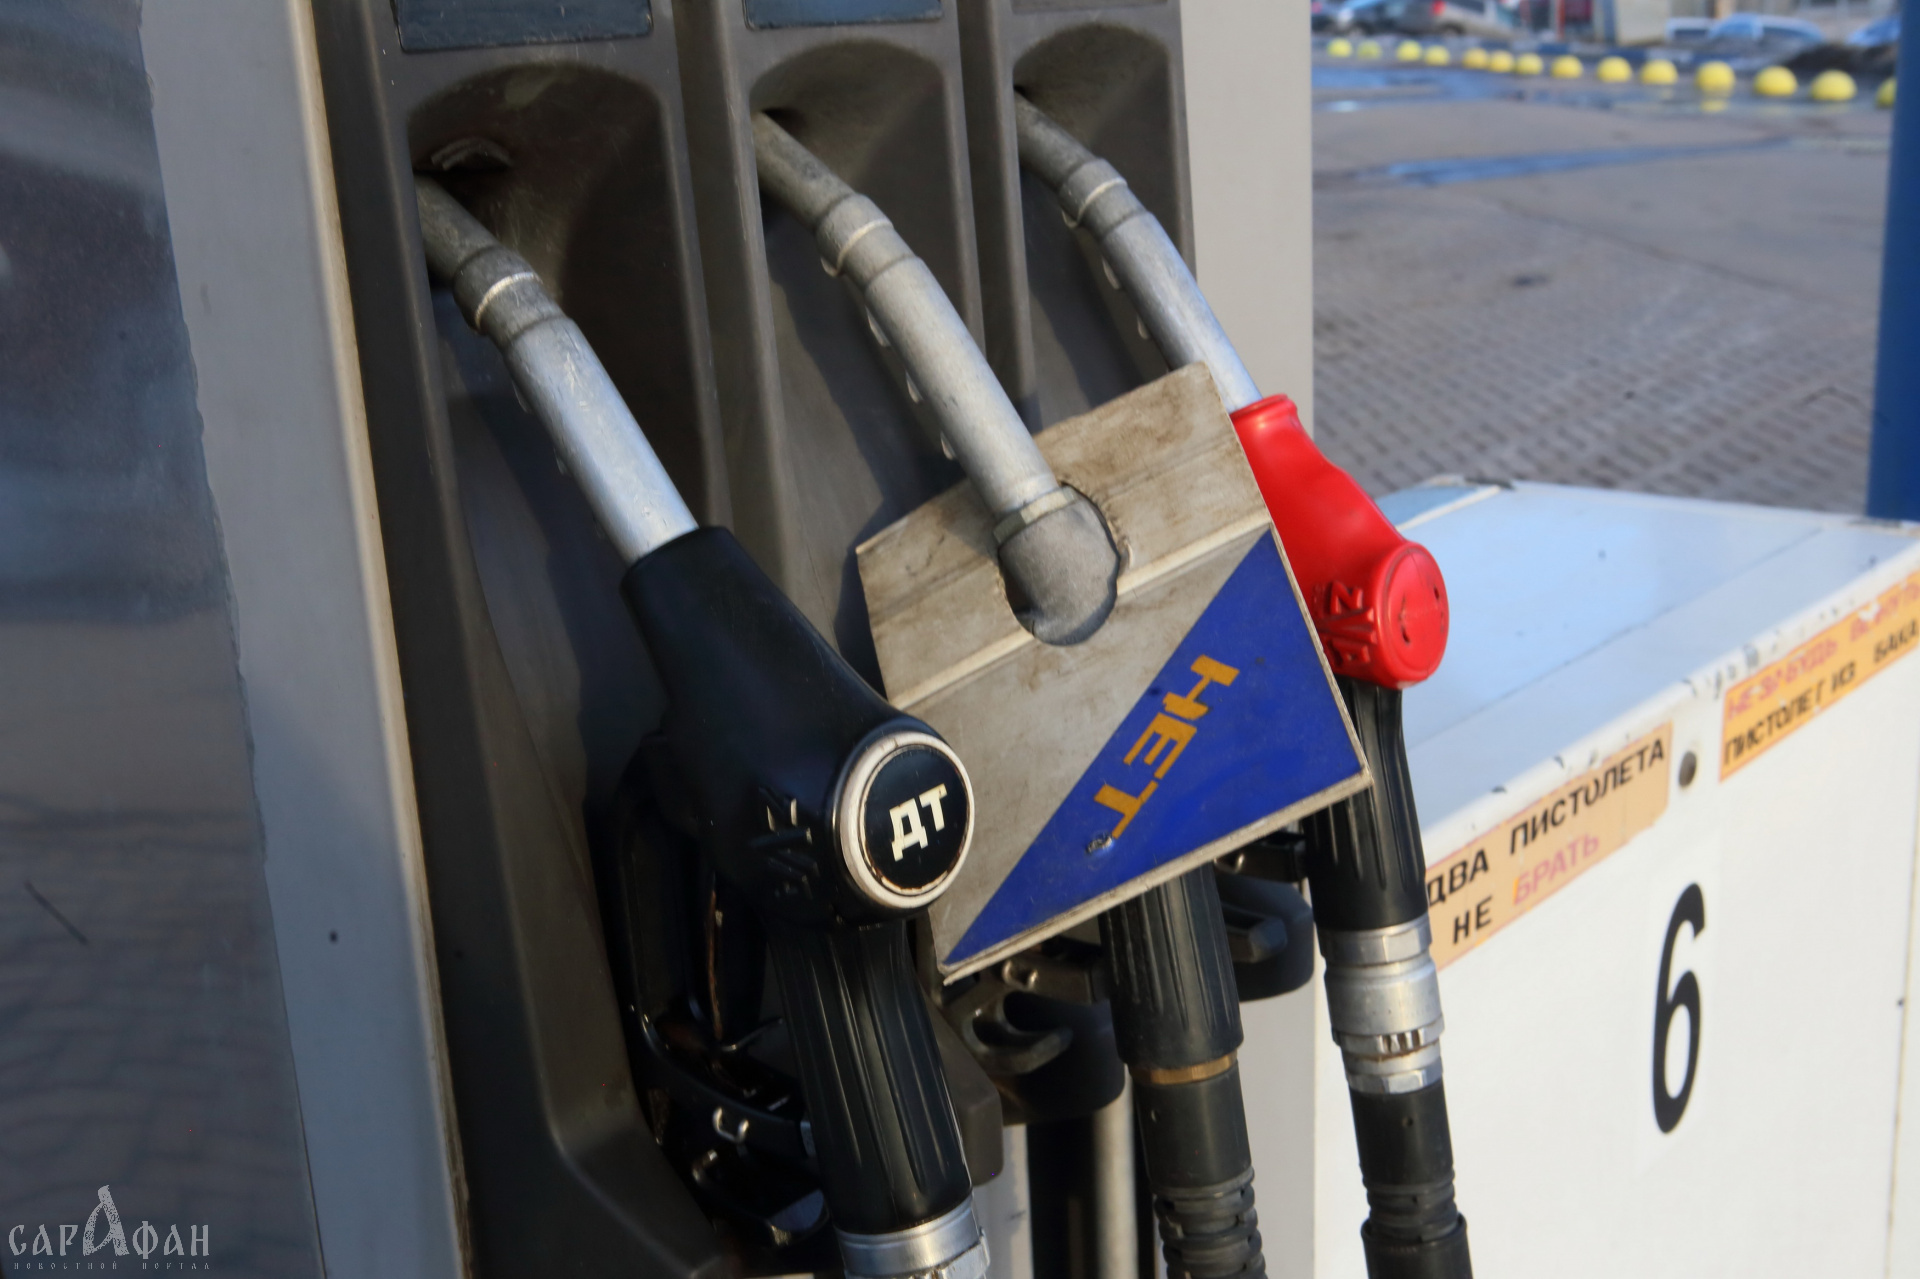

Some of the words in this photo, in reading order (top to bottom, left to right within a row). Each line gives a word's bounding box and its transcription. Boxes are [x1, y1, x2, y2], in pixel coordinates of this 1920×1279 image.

[1094, 654, 1239, 838] НЕТ
[1723, 668, 1825, 767] ПИСТОЛЕТ
[1832, 661, 1856, 693] ИЗ
[891, 784, 947, 861] ДТ
[1427, 847, 1489, 908] ДВА
[1509, 738, 1664, 856] ПИСТОЛЕТА
[1453, 896, 1493, 945] НЕ
[1512, 832, 1600, 906] БРАТЬ
[1652, 882, 1705, 1134] 6
